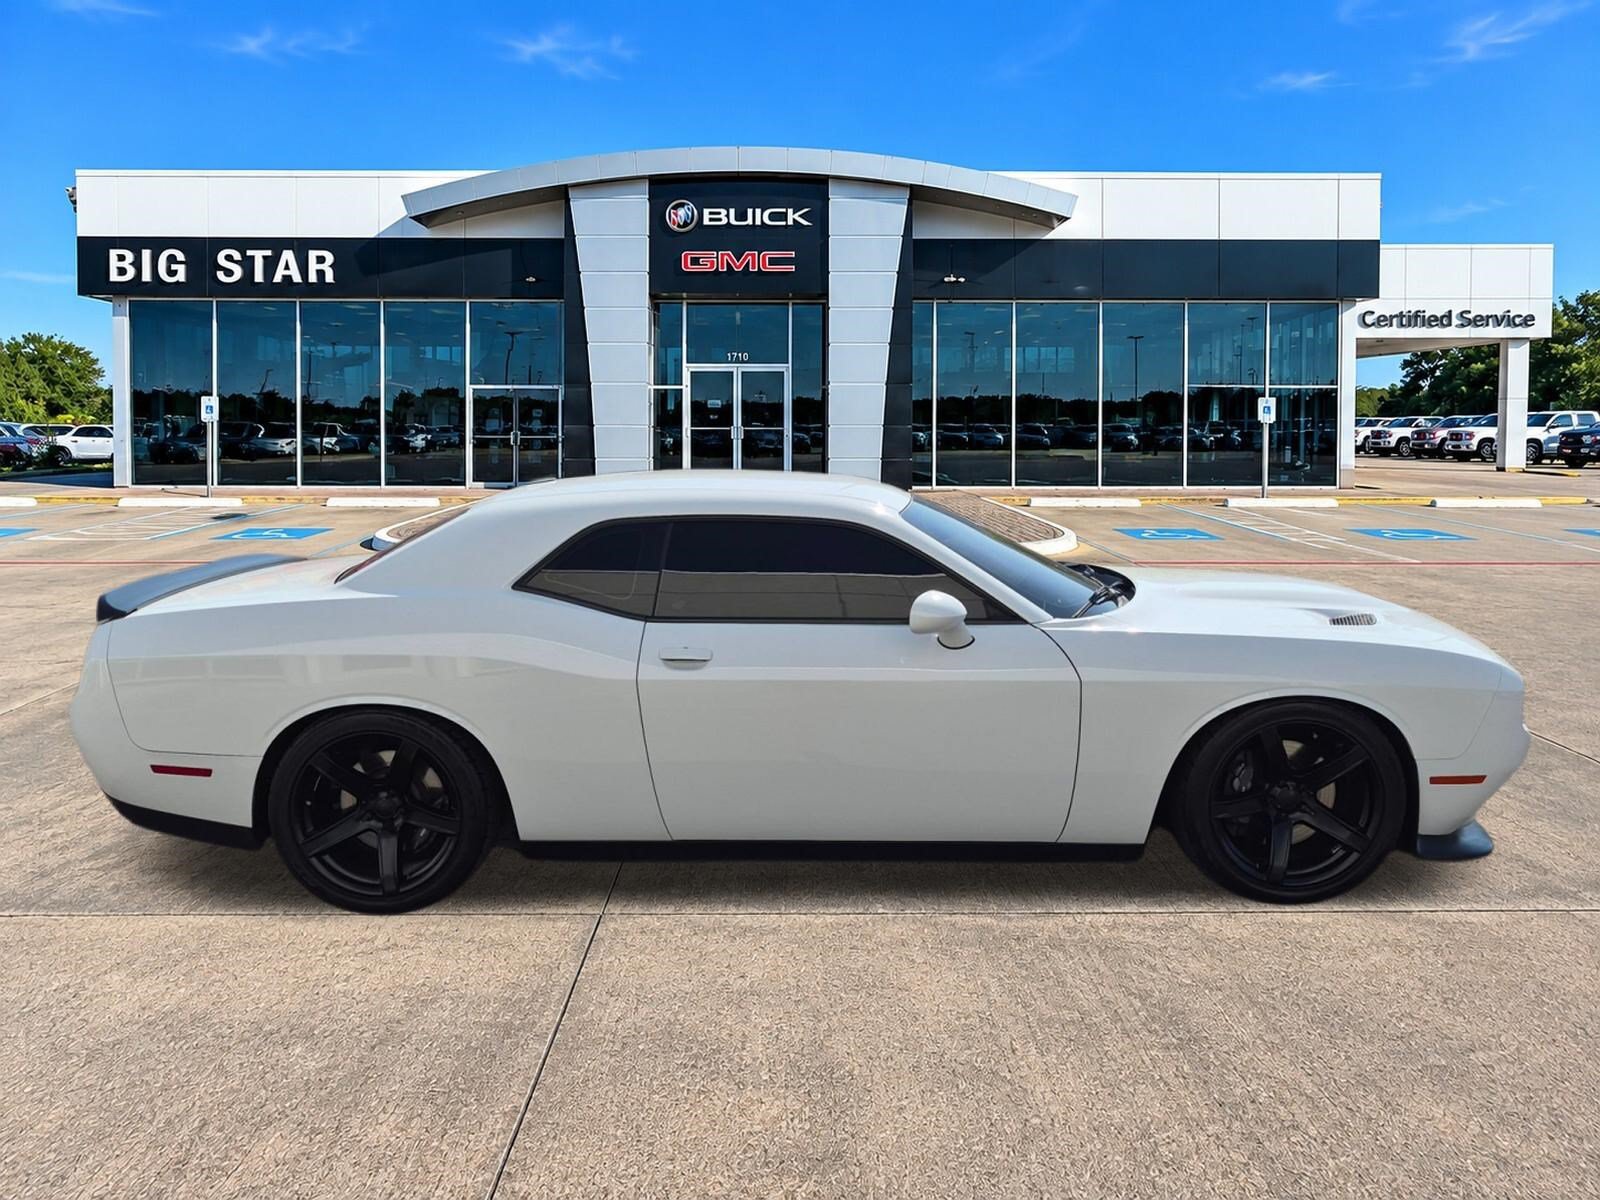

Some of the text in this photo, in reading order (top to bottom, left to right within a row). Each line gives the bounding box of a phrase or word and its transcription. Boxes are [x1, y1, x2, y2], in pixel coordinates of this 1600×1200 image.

[702, 207, 813, 226] BUICK
[108, 248, 336, 284] BIG STAR
[681, 251, 796, 272] GMC
[1359, 309, 1536, 329] Certified Service
[727, 352, 749, 361] 1710
